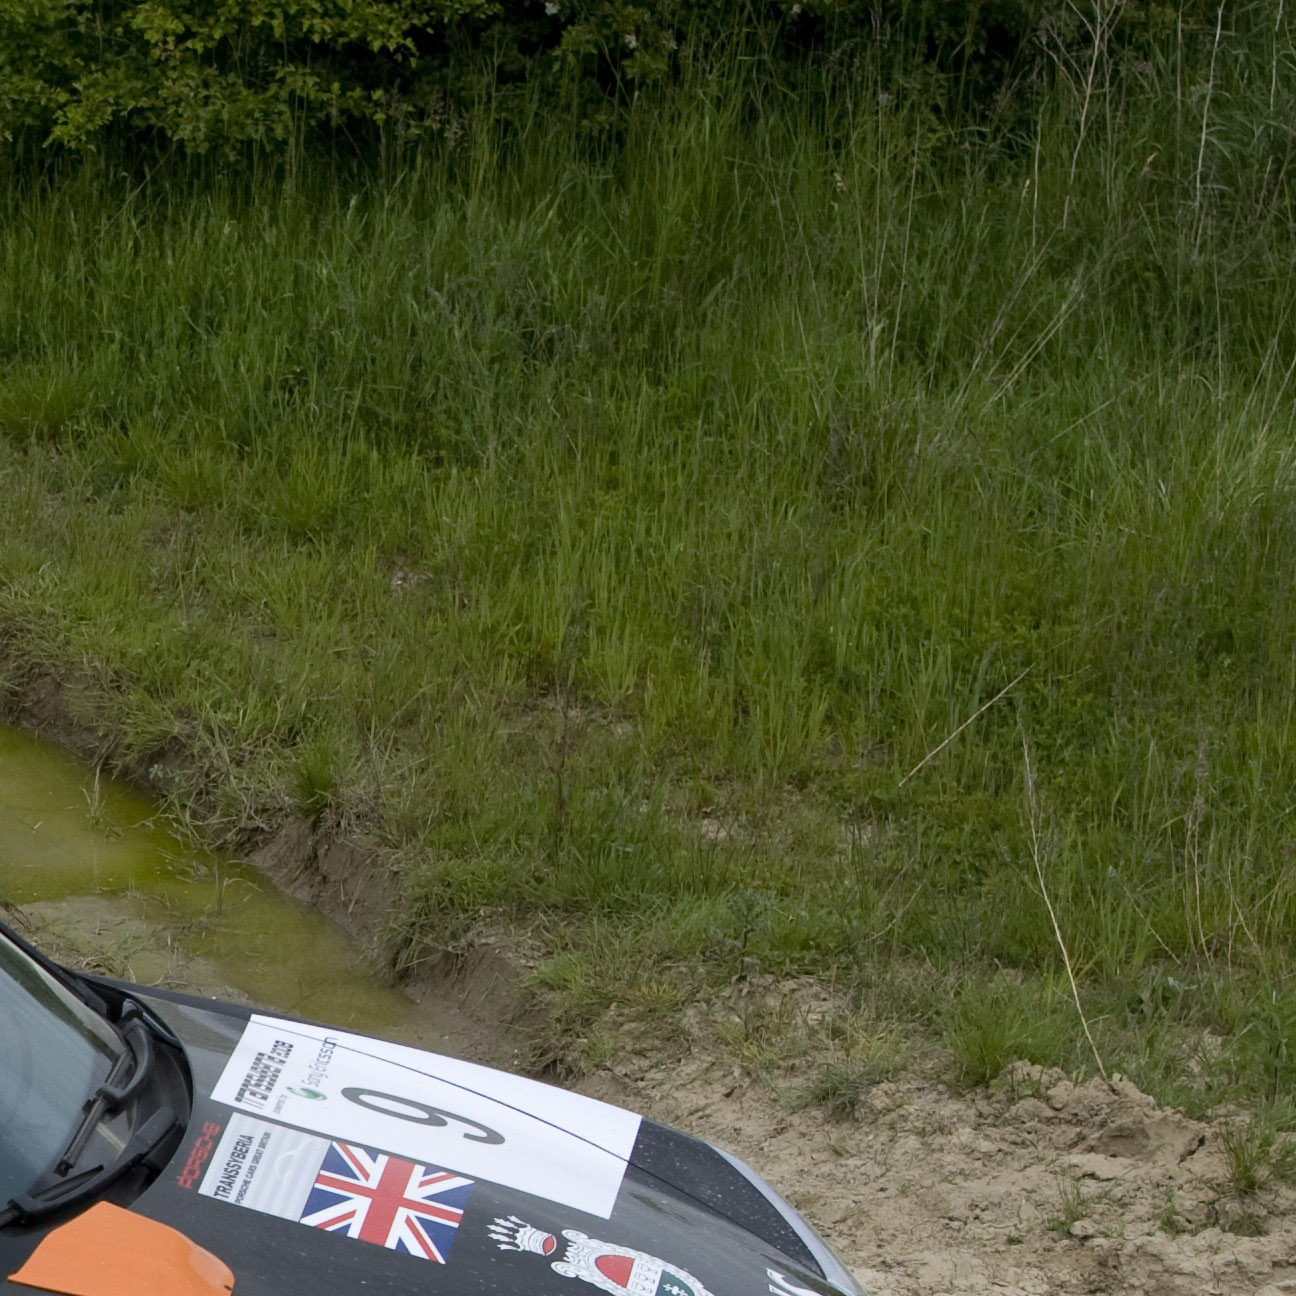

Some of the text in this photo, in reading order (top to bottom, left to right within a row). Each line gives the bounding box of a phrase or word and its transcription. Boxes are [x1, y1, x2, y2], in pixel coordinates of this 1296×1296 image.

[340, 1086, 507, 1146] 9
[177, 1121, 220, 1188] PORSCHE
[213, 1134, 255, 1198] TRANSSYBERIA
